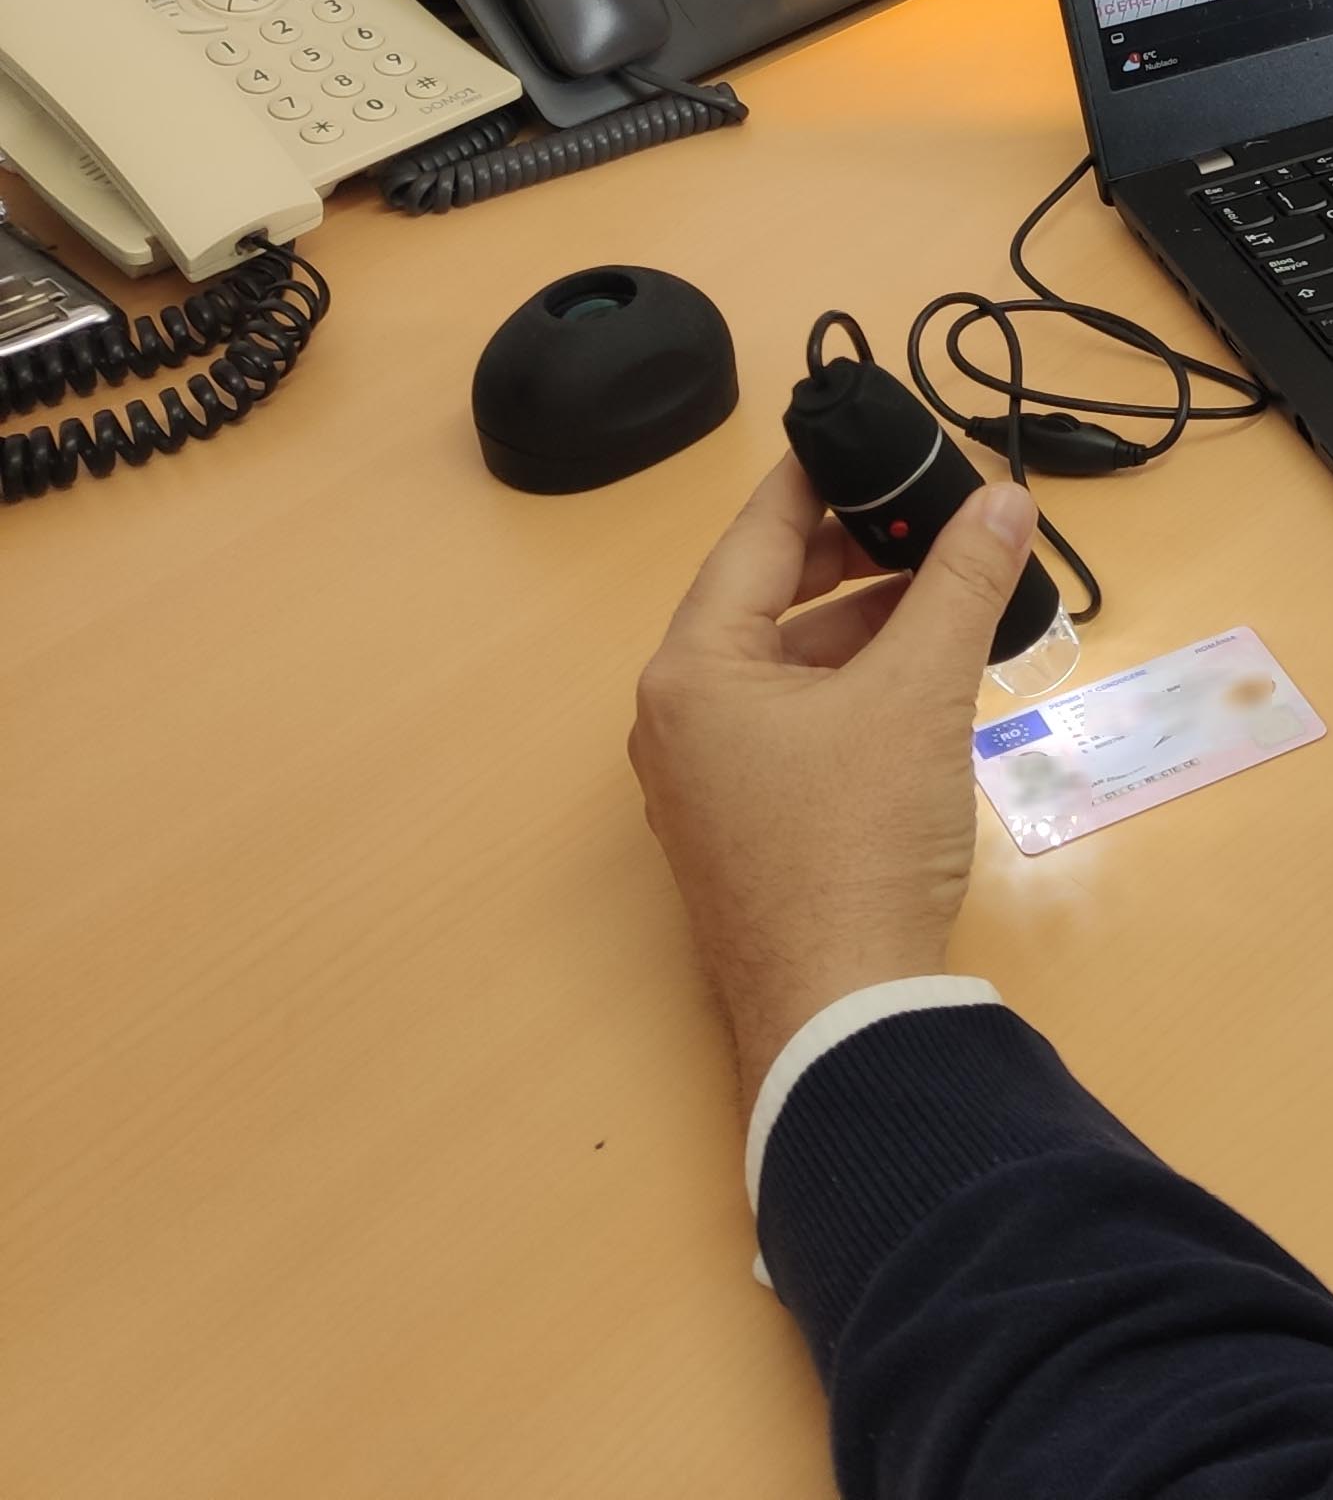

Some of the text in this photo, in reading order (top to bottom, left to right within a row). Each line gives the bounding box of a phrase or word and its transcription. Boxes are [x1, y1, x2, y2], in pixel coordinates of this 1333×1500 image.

[324, 0, 341, 13] 3
[272, 19, 293, 34] 2
[358, 27, 373, 40] 6
[221, 41, 235, 54] 1
[303, 48, 321, 62] 5
[386, 53, 402, 65] 9
[1145, 57, 1179, 71] Nublado
[254, 69, 270, 82] 4
[334, 74, 352, 87] 8
[280, 96, 295, 109] 7
[366, 98, 384, 110] 0
[1000, 727, 1022, 742] RO
